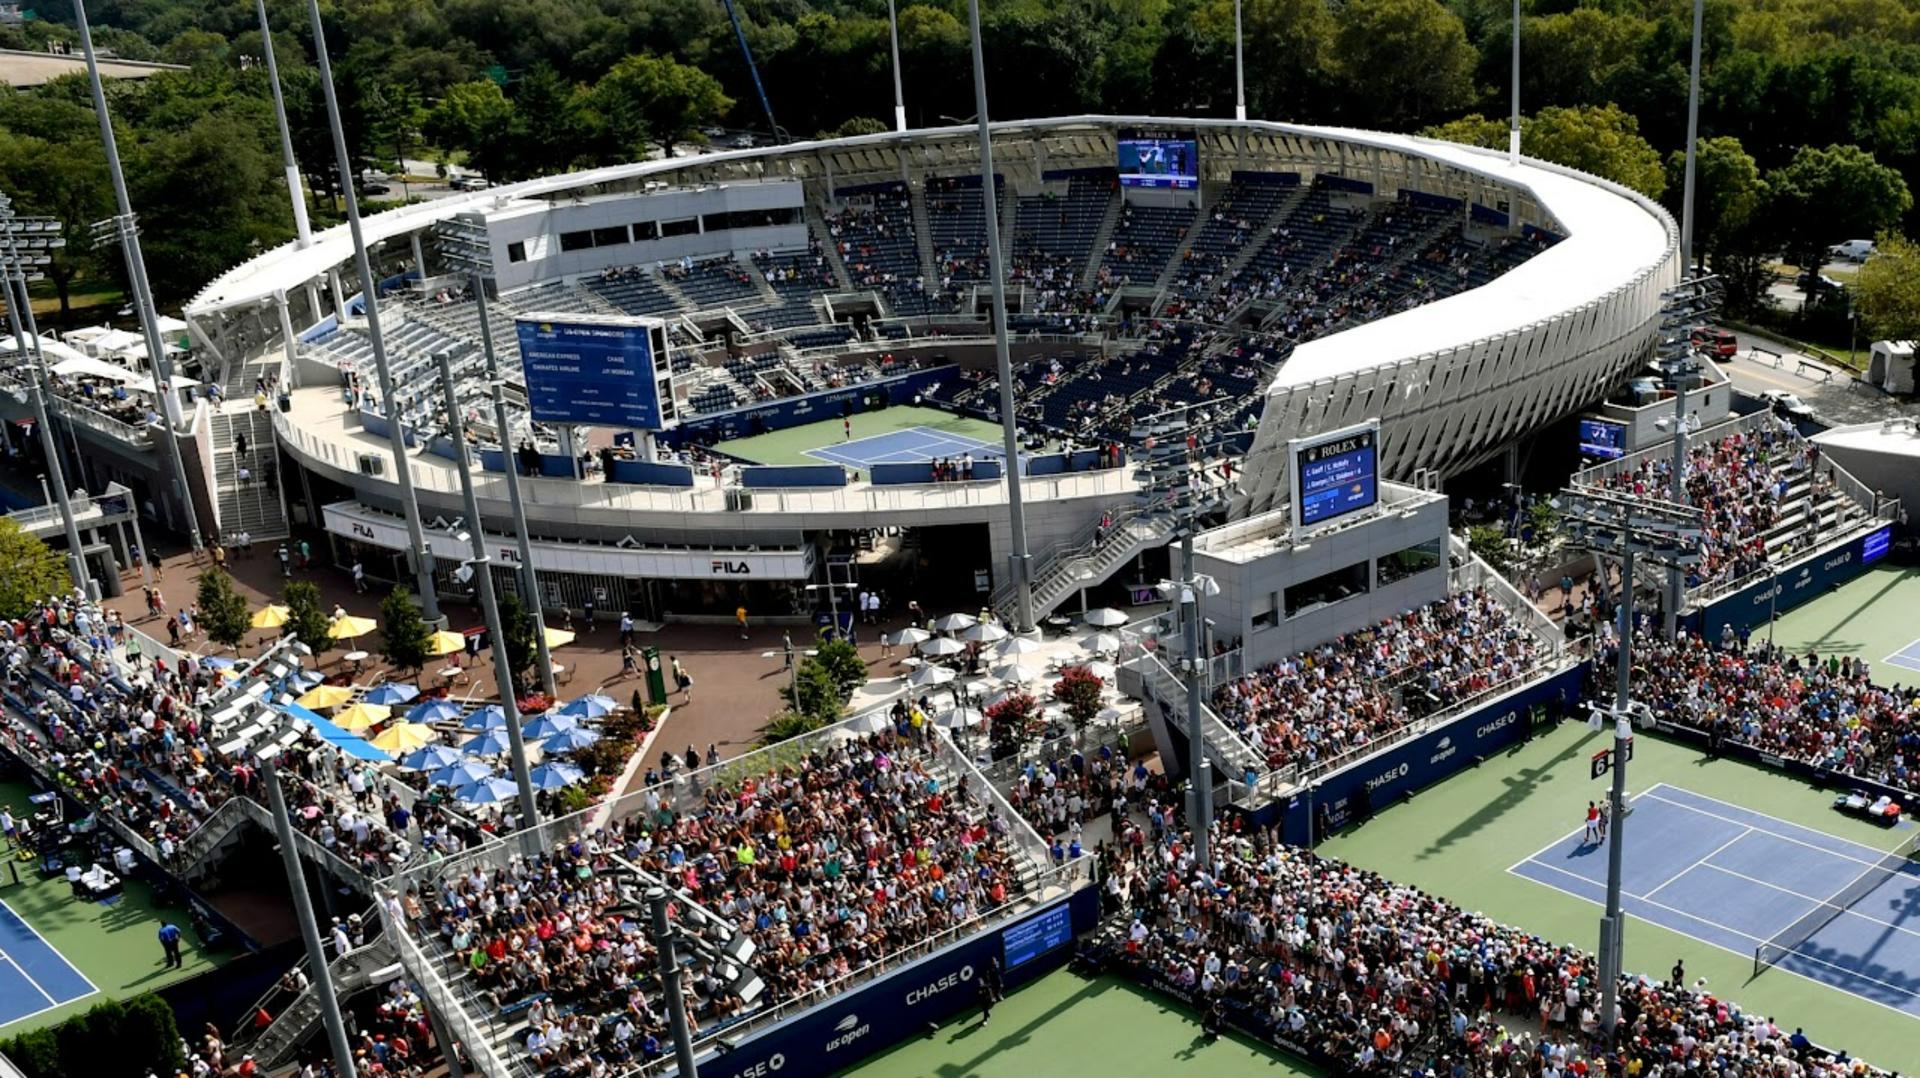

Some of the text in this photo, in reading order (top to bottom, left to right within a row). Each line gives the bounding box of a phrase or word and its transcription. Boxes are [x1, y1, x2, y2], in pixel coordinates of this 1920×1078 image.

[22, 424, 32, 437] 7
[1322, 440, 1357, 457] ROLEX
[352, 522, 374, 539] FILA
[501, 549, 522, 562] FIL
[712, 561, 750, 574] FILA
[470, 634, 481, 650] 7
[1476, 715, 1508, 738] CHASE
[1595, 758, 1605, 775] 6
[906, 972, 958, 1005] CHASE
[841, 1024, 870, 1049] open
